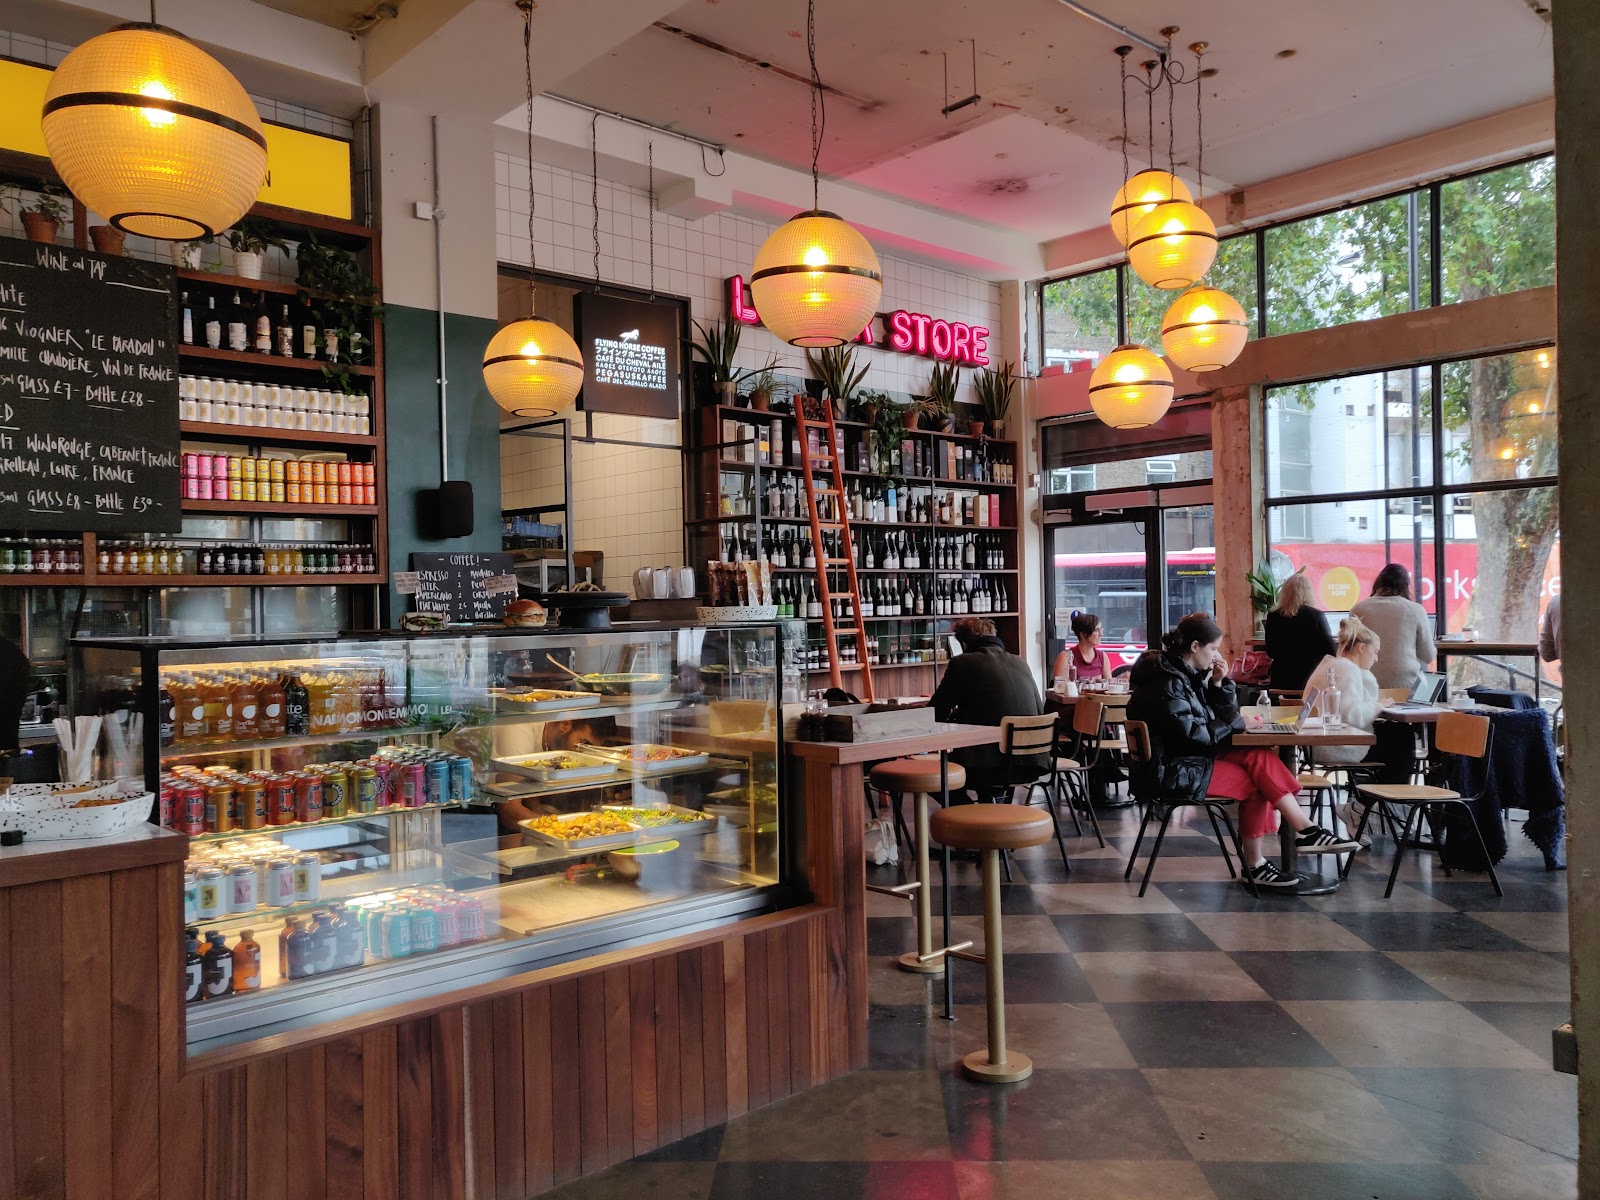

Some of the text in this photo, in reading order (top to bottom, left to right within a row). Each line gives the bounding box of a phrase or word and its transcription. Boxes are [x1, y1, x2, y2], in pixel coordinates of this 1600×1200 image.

[36, 246, 70, 272] WINE
[88, 259, 107, 281] TAP
[595, 338, 666, 355] FLYING HORSE COFFEE
[891, 310, 990, 366] STORE
[0, 346, 30, 362] MILLE
[102, 358, 121, 376] VIN
[124, 363, 134, 375] DE
[138, 364, 175, 382] FRANCE
[626, 358, 650, 368] CHEVAL
[596, 368, 666, 384] PEGASUSKAFFEE
[17, 374, 50, 395] GLASS
[85, 385, 119, 403] BOTTLE
[100, 445, 147, 467] CABERNET
[148, 453, 179, 468] FRANC
[93, 465, 135, 484] FRANCE
[28, 489, 63, 508] GLASS
[95, 492, 125, 510] BOTTLE
